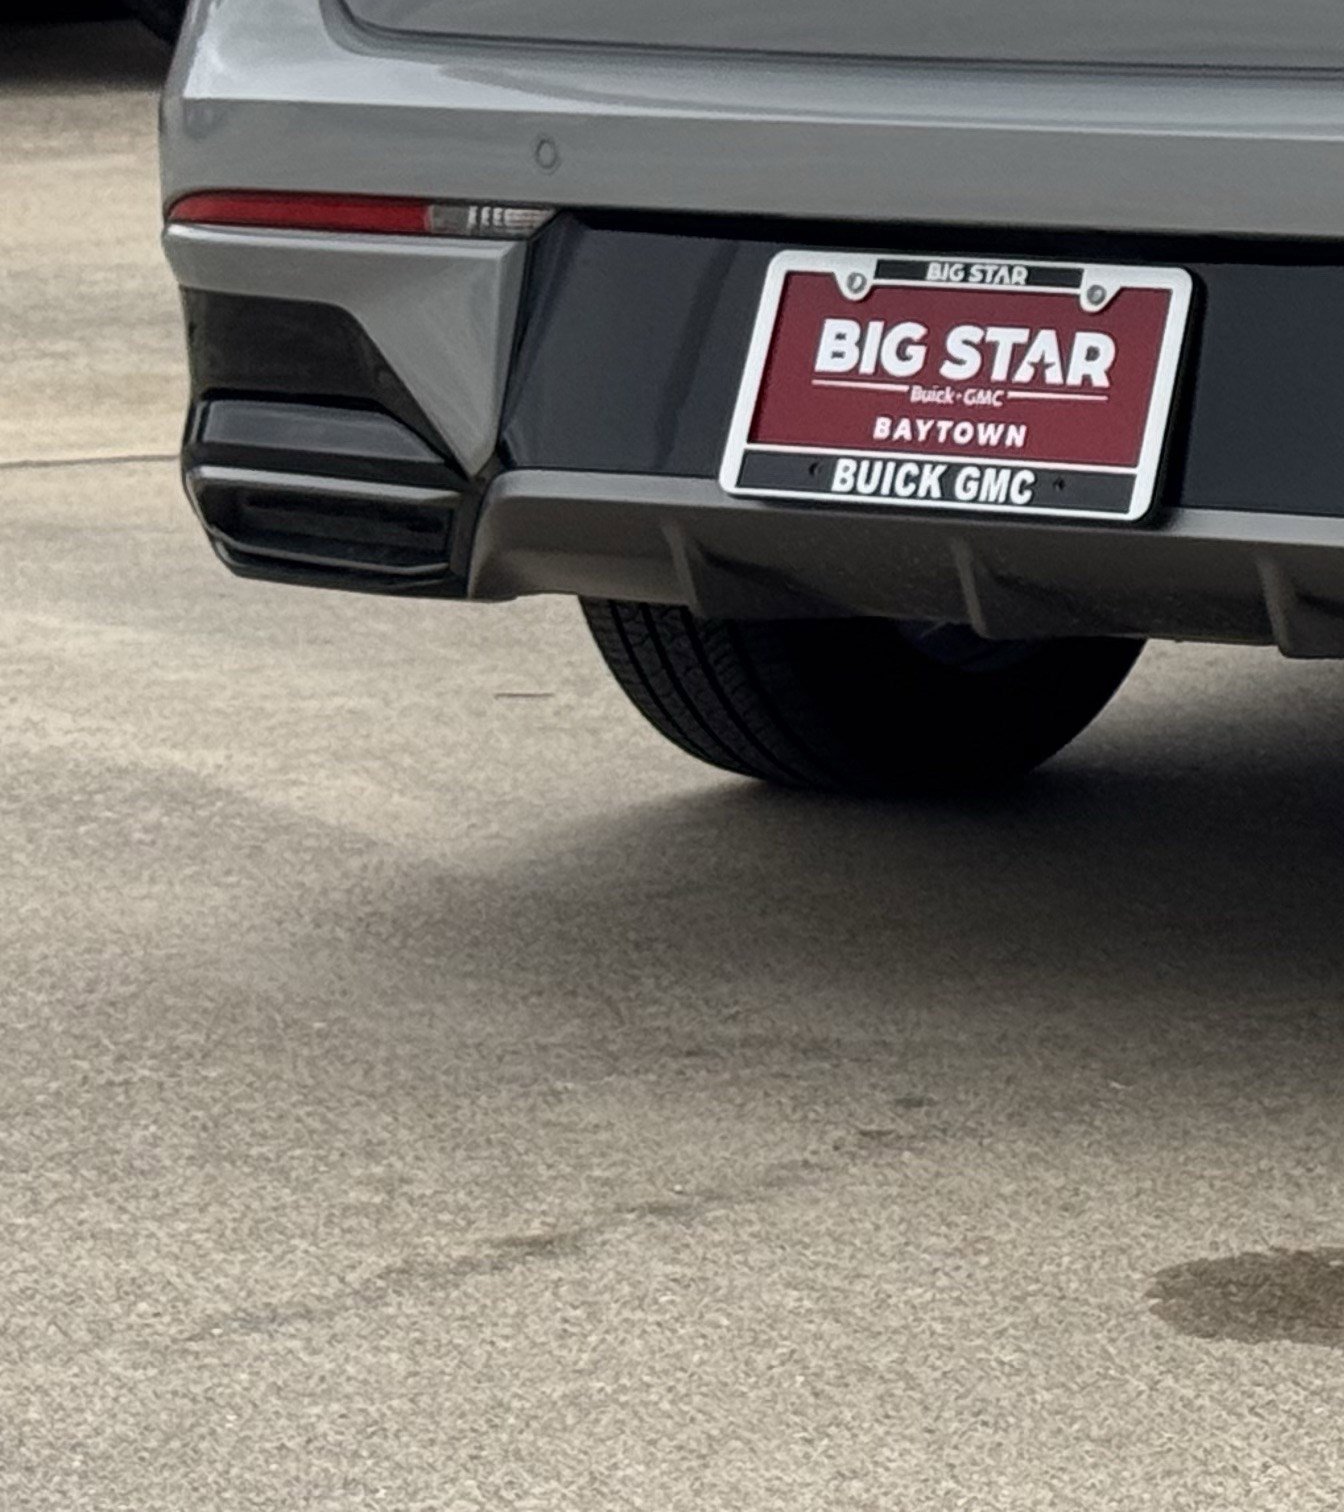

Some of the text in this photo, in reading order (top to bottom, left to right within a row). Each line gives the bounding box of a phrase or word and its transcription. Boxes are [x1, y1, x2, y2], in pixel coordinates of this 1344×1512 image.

[925, 261, 1029, 287] BIG STAR
[814, 318, 1117, 388] BIG STAR
[873, 416, 1027, 448] BAYTOWN
[831, 458, 1036, 505] BUICK GMC
